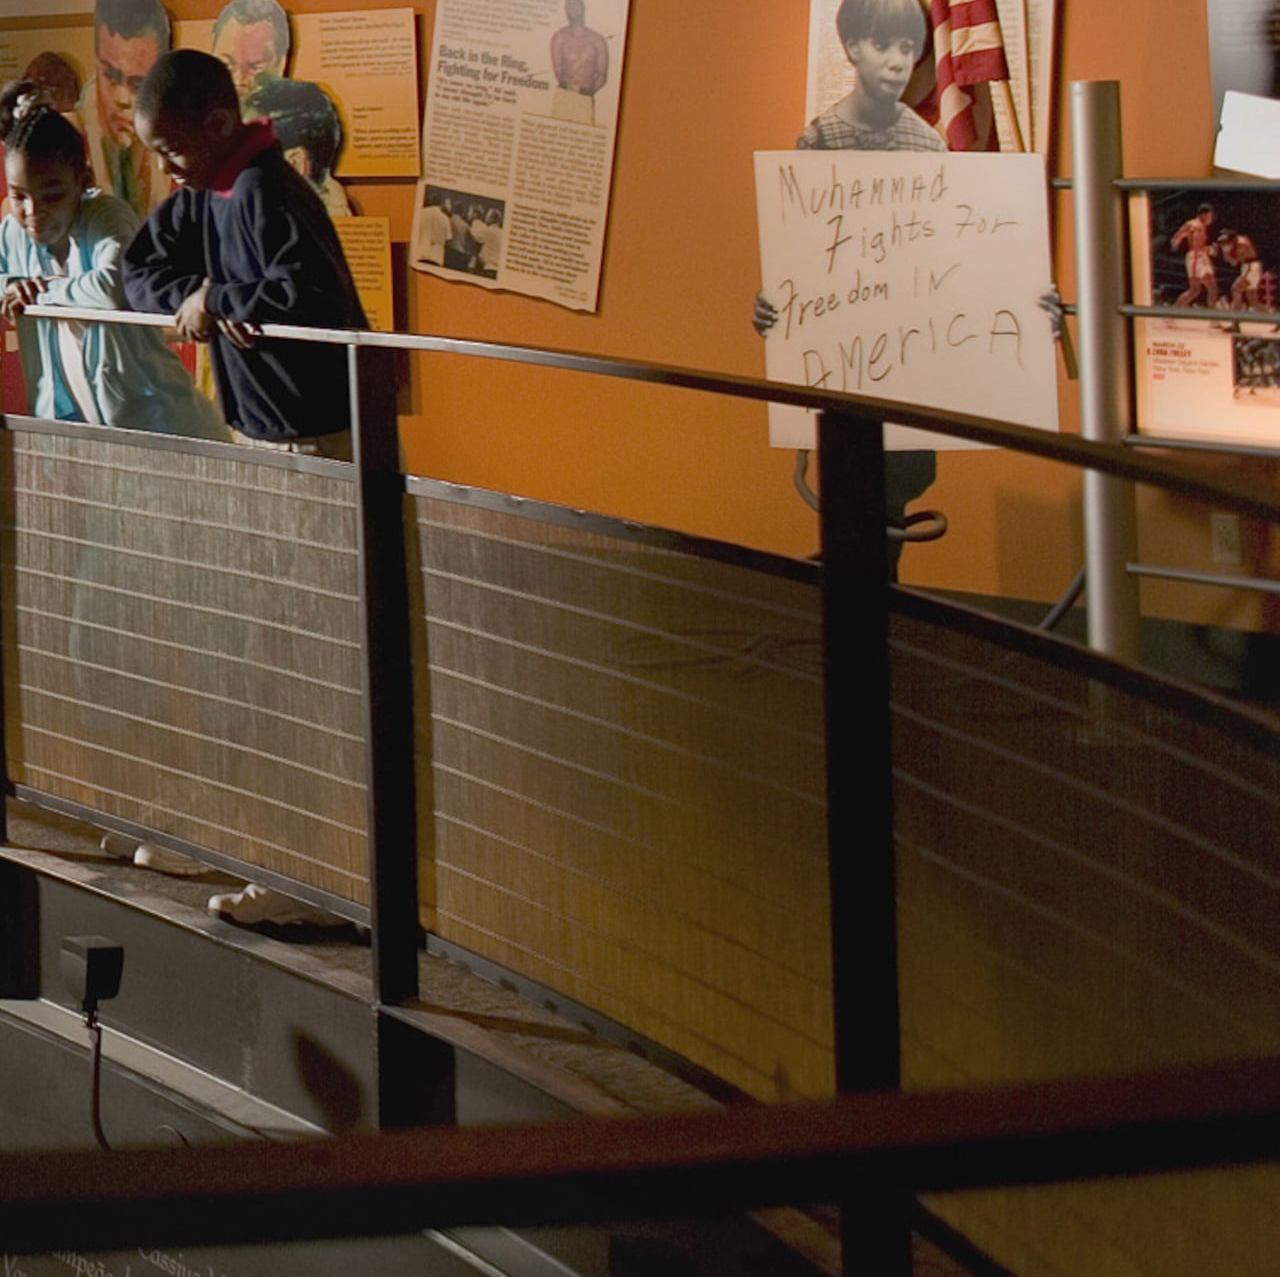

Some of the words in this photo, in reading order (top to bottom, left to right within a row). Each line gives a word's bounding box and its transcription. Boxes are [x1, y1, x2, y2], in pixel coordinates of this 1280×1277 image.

[439, 44, 466, 60] Back
[468, 49, 478, 63] in
[480, 52, 498, 66] the
[501, 55, 529, 72] Ring,
[437, 60, 482, 81] Fighting
[483, 67, 499, 81] for
[501, 71, 549, 91] Freedom
